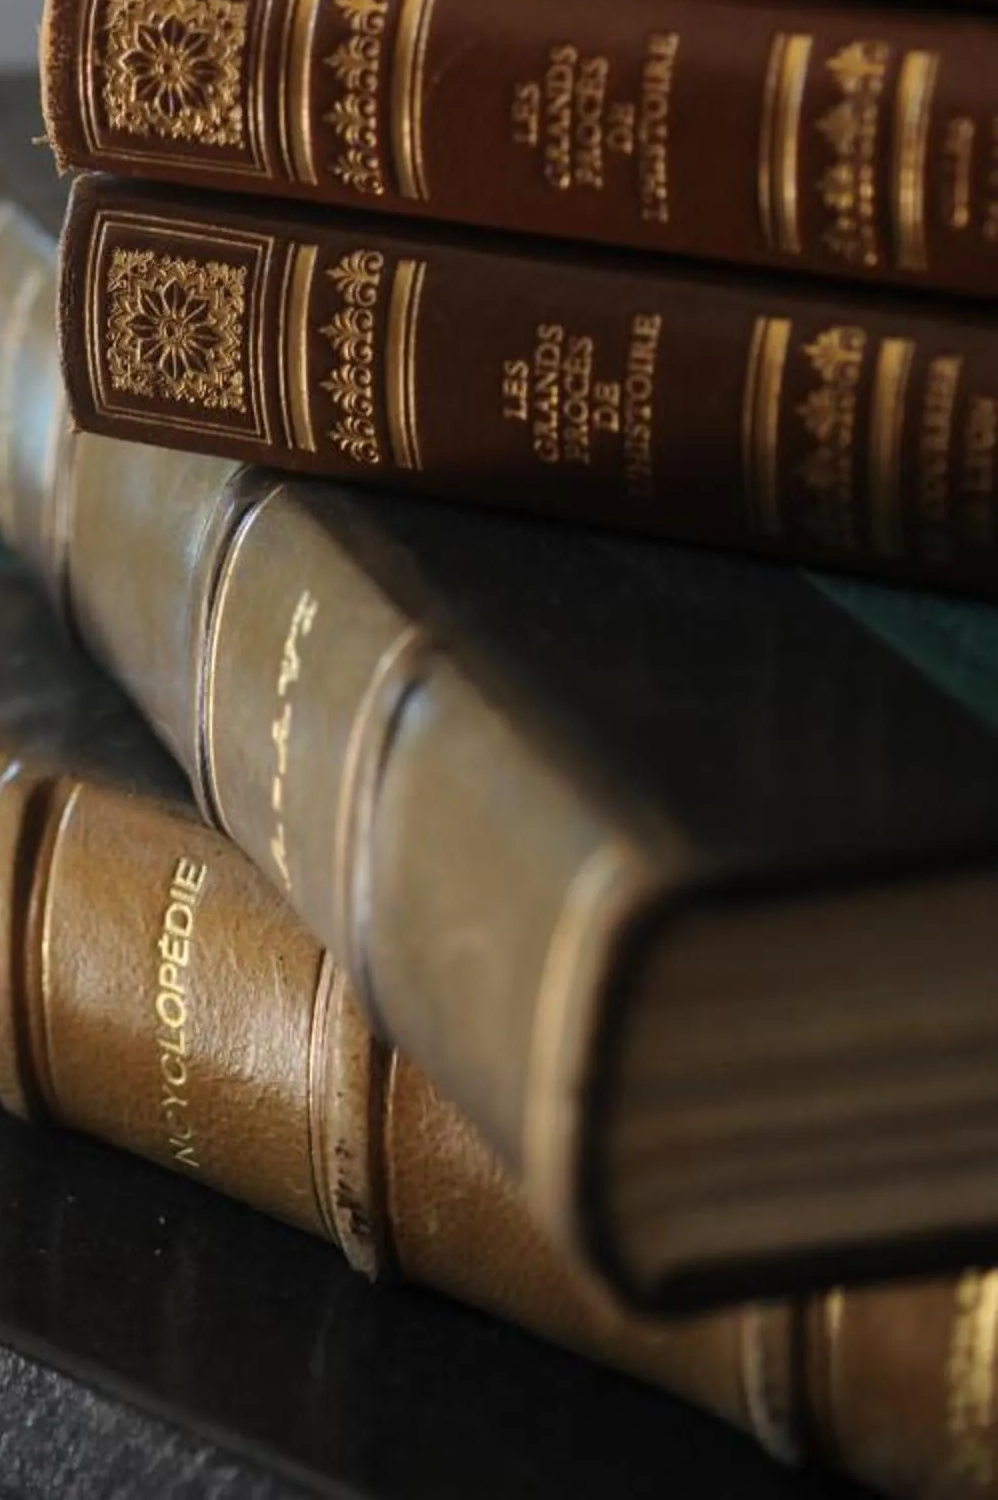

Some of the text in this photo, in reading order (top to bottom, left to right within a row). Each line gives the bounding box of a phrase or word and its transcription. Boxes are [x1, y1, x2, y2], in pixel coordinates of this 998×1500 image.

[511, 80, 540, 147] LES
[544, 43, 578, 191] GRANDS
[605, 102, 634, 155] DE
[501, 359, 529, 422] LES
[533, 323, 564, 464] GRANDS
[592, 381, 621, 433] DE
[155, 857, 207, 1168] NCYCLOPÉDIE
